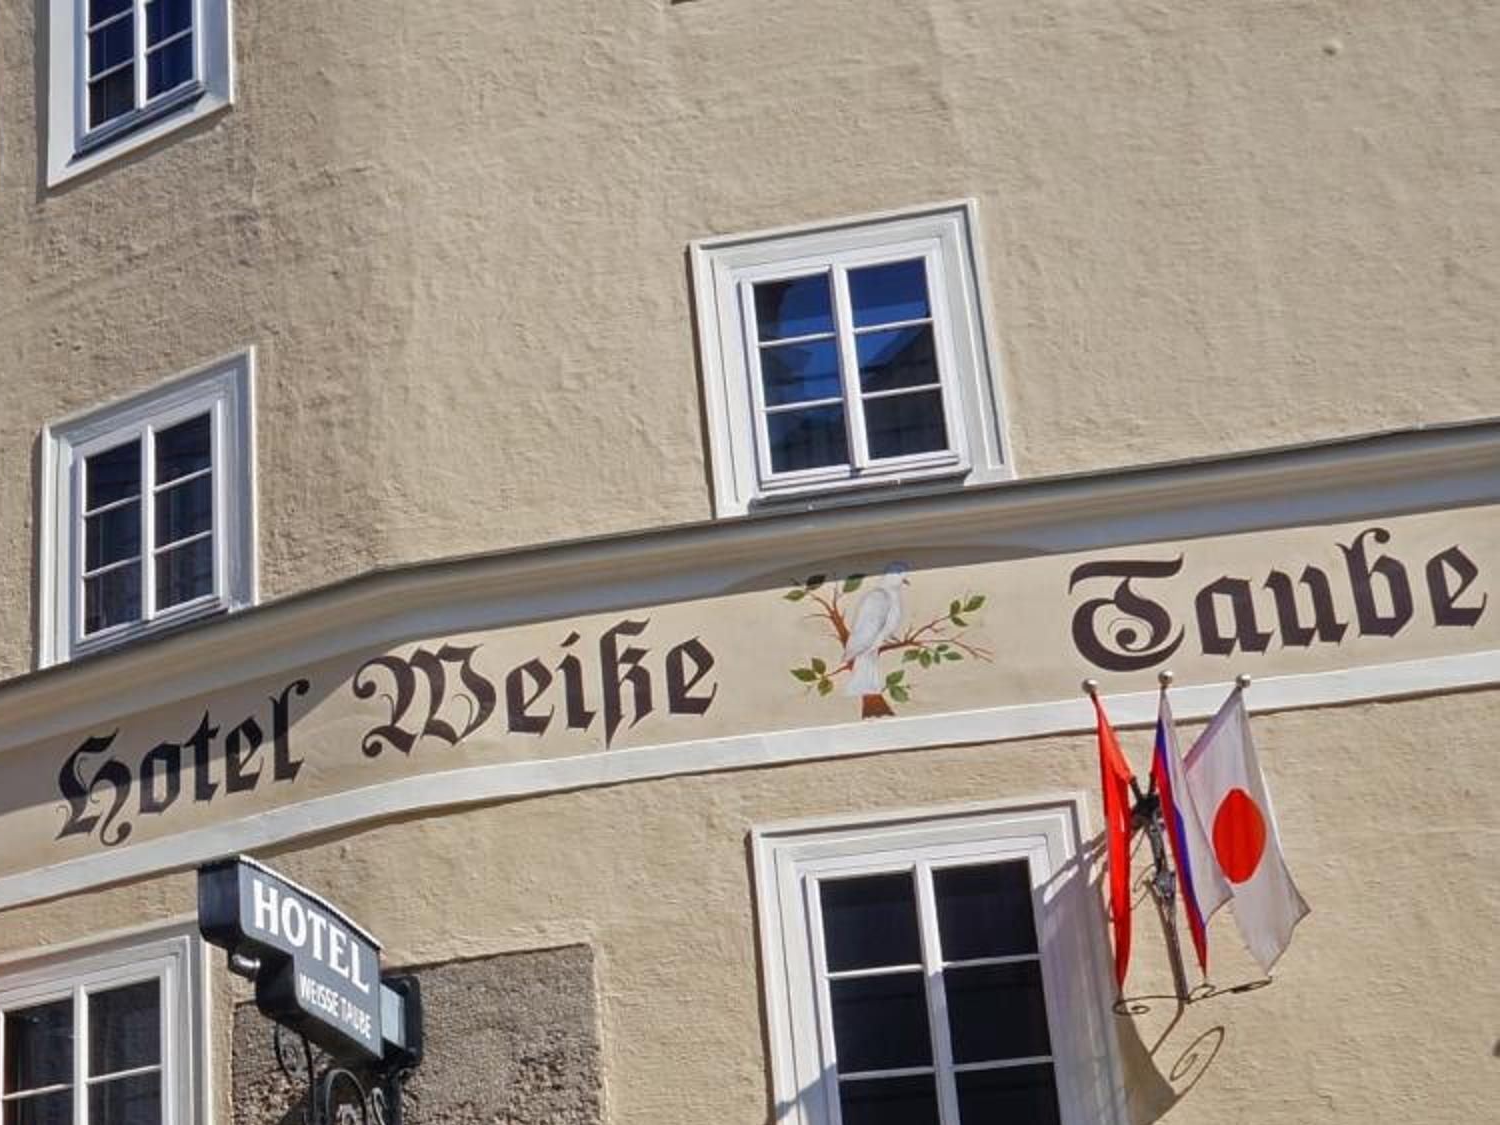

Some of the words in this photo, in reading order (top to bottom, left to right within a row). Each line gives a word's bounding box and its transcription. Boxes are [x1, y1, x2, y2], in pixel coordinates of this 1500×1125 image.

[55, 679, 311, 846] Hotel
[1068, 527, 1488, 672] Taube
[252, 880, 370, 993] HOTEL
[299, 972, 339, 1017] WEISSE
